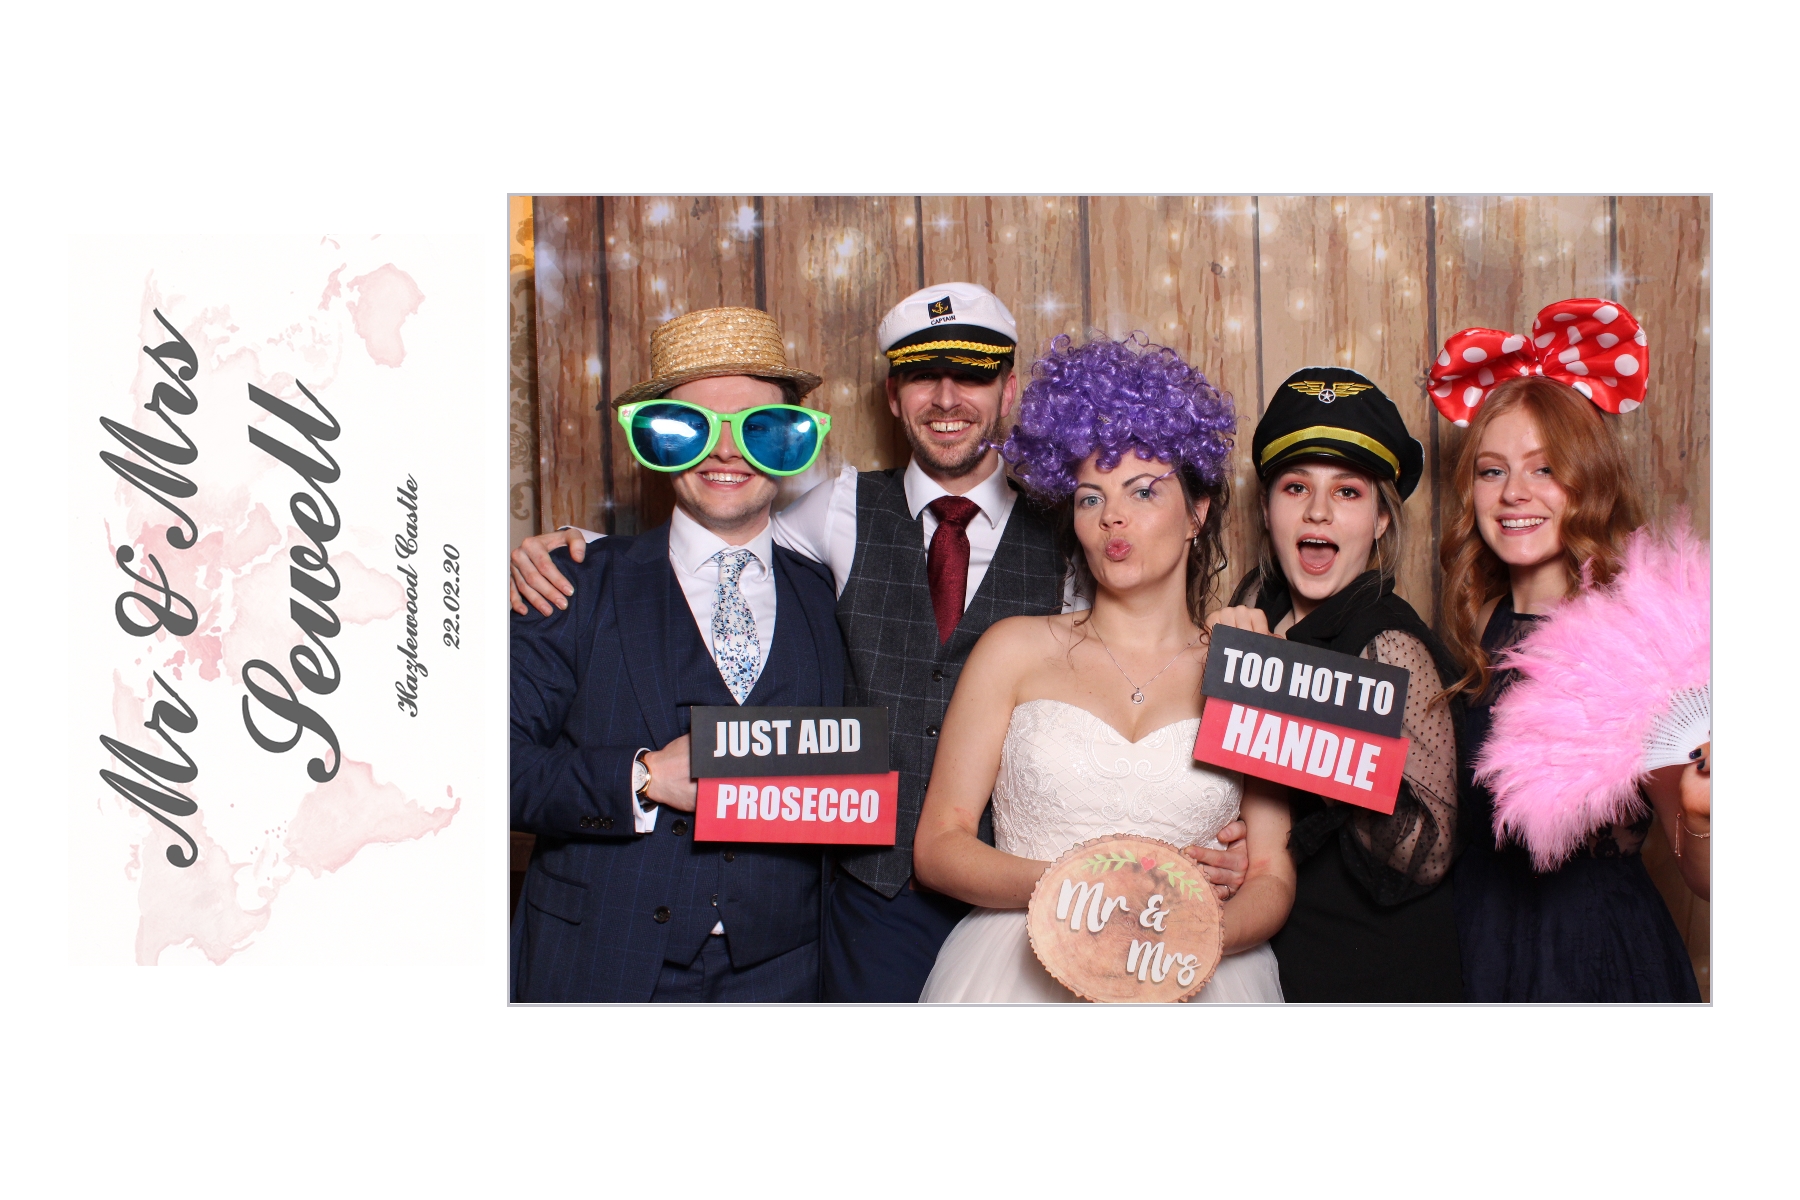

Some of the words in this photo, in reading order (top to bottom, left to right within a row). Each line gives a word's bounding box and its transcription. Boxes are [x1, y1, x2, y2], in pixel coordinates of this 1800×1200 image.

[931, 315, 956, 326] CAPTAIN
[1223, 647, 1284, 693] TOO
[1288, 662, 1353, 707] HOT
[1358, 675, 1395, 716] TO
[713, 719, 792, 758] JUST
[797, 718, 861, 755] ADD
[1221, 703, 1382, 791] HANDLE
[716, 783, 880, 824] PROSECCO
[1056, 878, 1130, 933] Mr
[1139, 894, 1170, 932] &
[1126, 939, 1202, 986] Mrs
